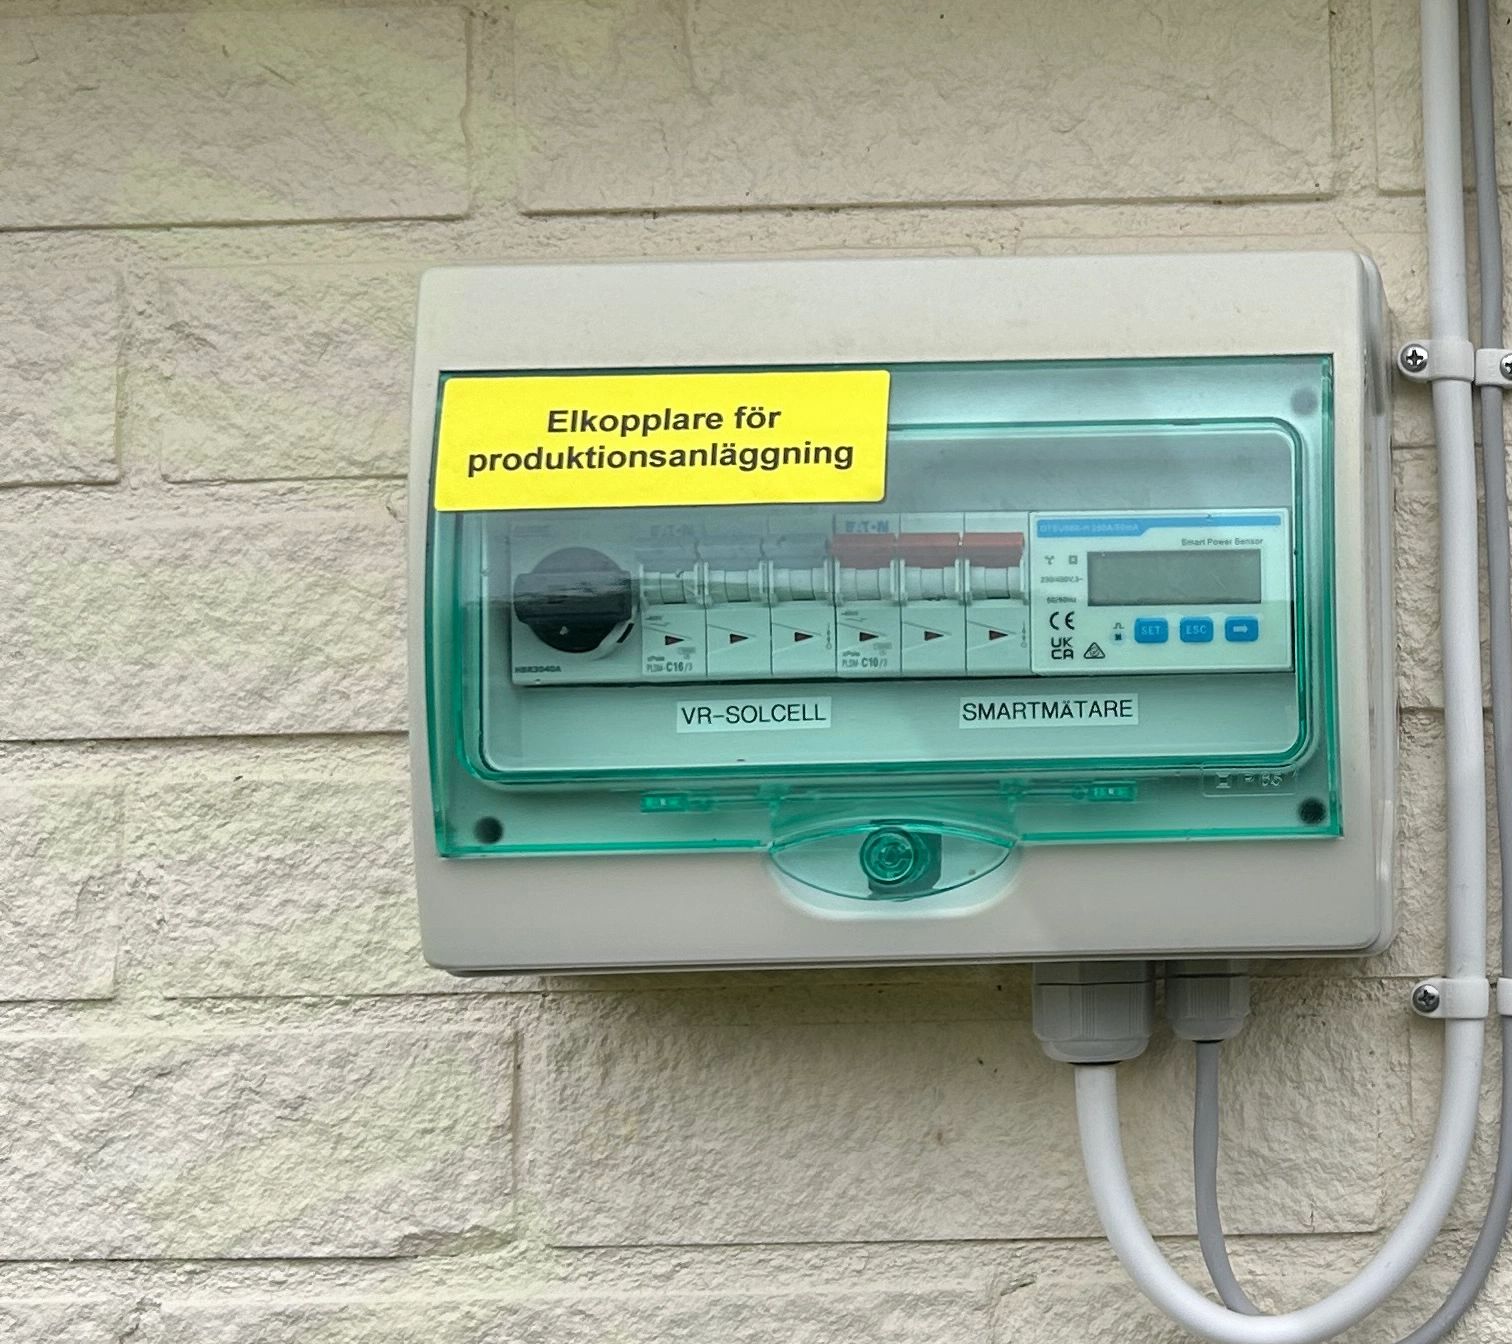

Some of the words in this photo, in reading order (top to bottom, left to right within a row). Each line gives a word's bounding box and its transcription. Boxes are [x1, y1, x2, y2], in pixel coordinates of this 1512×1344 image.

[547, 408, 724, 438] Elkopplare
[734, 405, 782, 429] för
[468, 441, 854, 477] produktionsanläggning
[1181, 538, 1206, 546] Smart
[1207, 538, 1232, 546] Power
[1234, 538, 1263, 546] Sensor
[1141, 625, 1161, 636] SET
[1185, 624, 1208, 635] ESC
[681, 703, 826, 725] VR-SOLCELL
[961, 699, 1133, 722] SMARTMÄTARE
